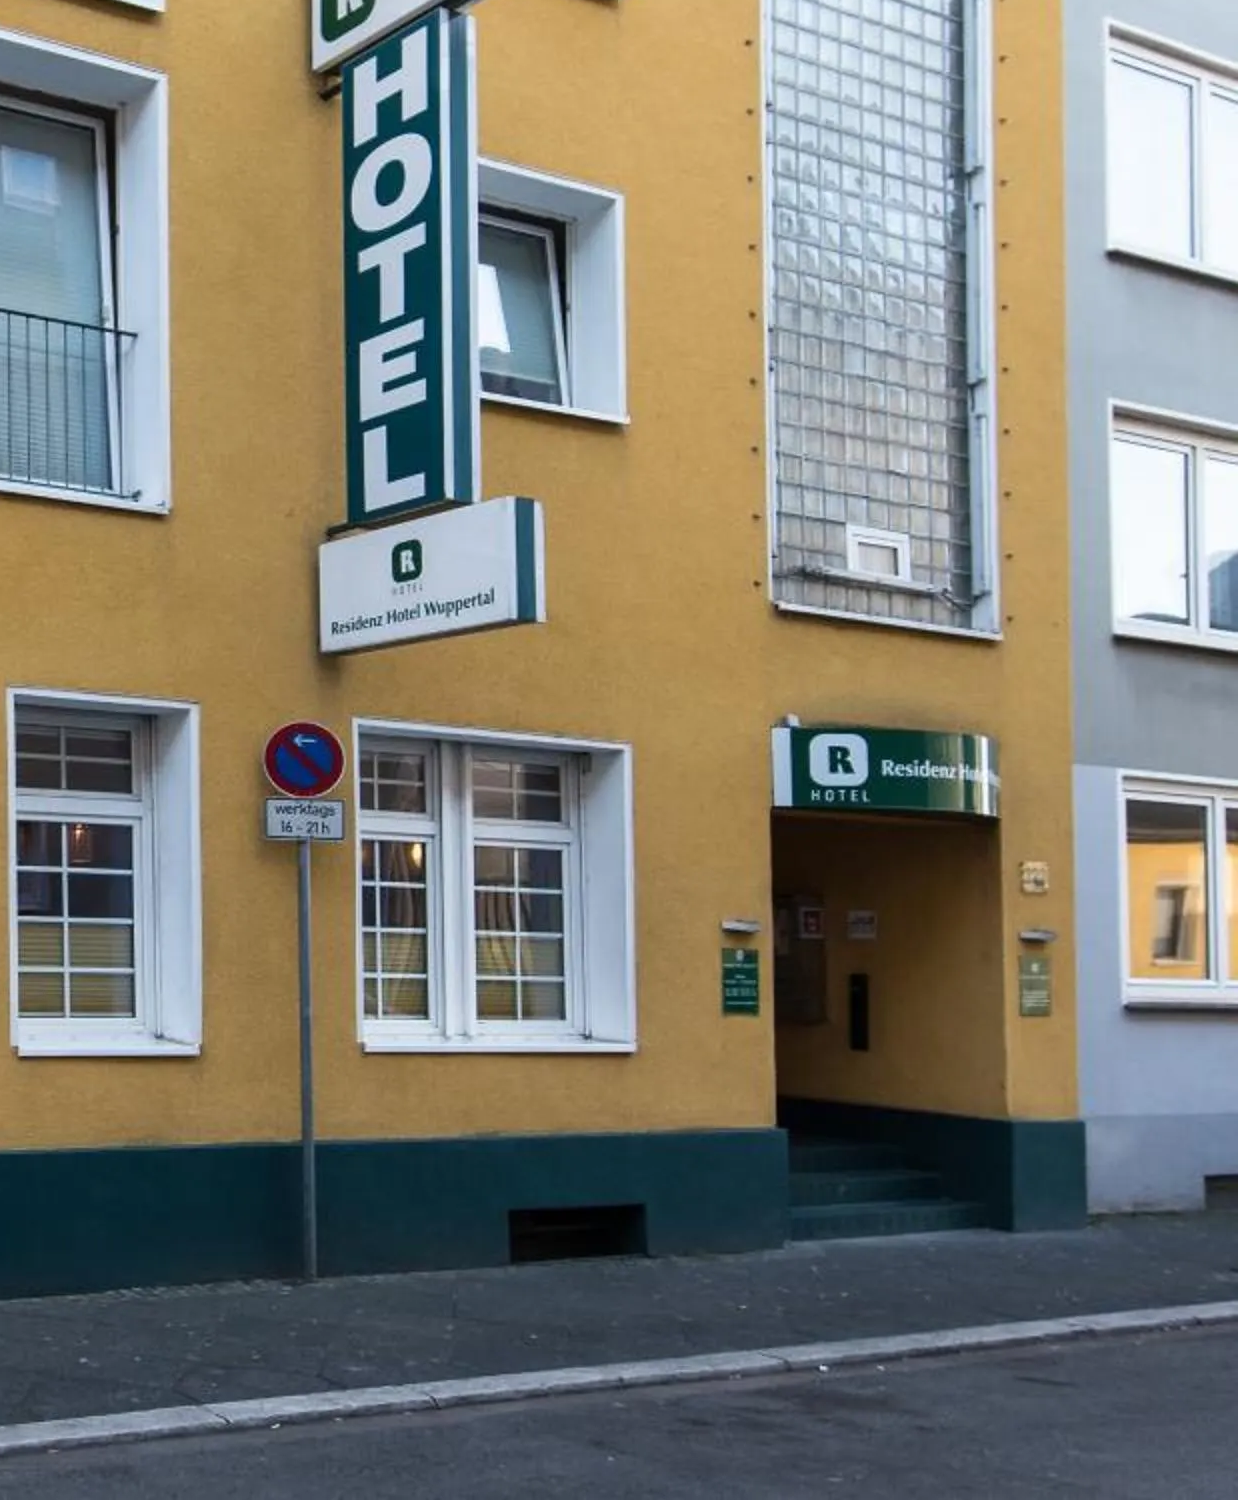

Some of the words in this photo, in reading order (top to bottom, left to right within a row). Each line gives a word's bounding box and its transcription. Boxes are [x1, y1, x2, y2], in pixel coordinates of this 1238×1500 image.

[350, 25, 433, 513] HOTEL
[391, 583, 424, 596] HOTEL
[331, 614, 382, 636] Residenz
[386, 603, 421, 625] Hotel
[423, 588, 495, 618] Wuppertal
[828, 745, 855, 774] R
[881, 759, 956, 780] Residenz
[811, 789, 870, 802] HOTEL
[275, 803, 336, 818] werktags
[281, 821, 293, 833] 16
[306, 821, 319, 834] 21
[321, 821, 331, 834] h
